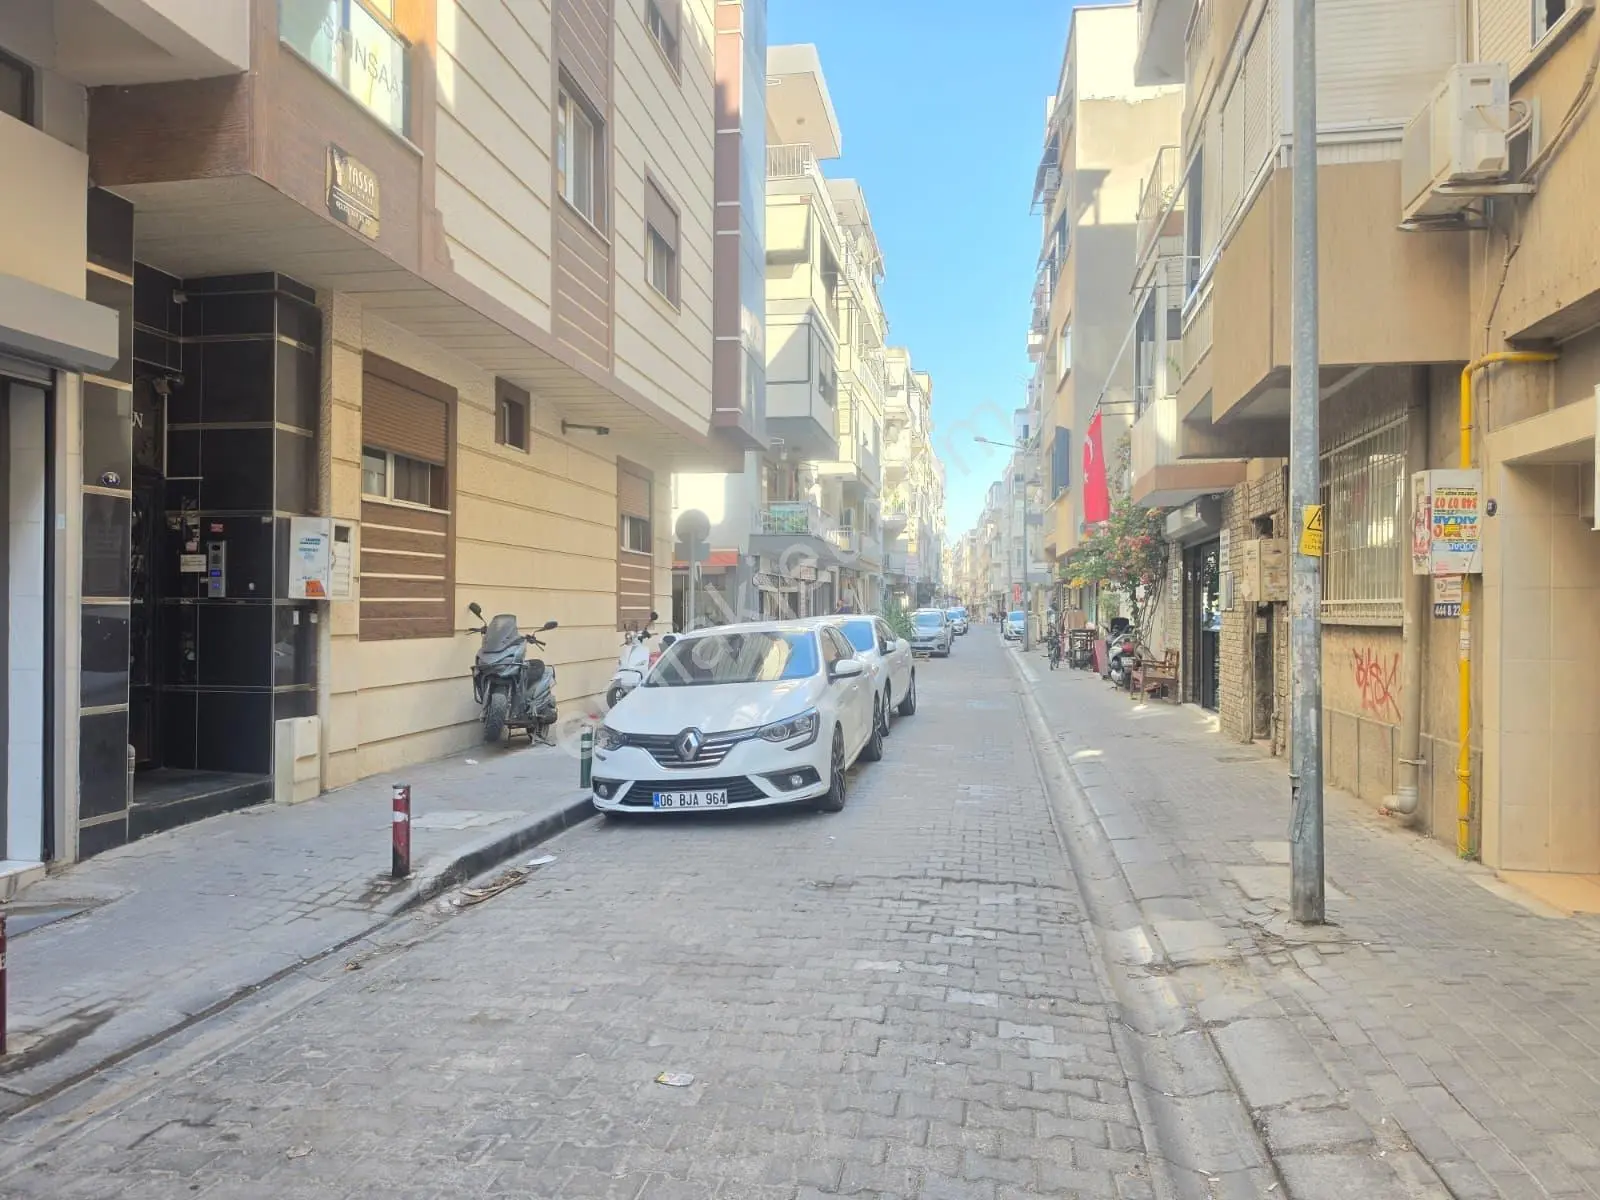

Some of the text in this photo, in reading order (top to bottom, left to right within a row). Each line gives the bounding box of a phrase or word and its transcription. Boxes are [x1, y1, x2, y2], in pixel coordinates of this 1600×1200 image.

[660, 792, 726, 807] 06 BJA 964
